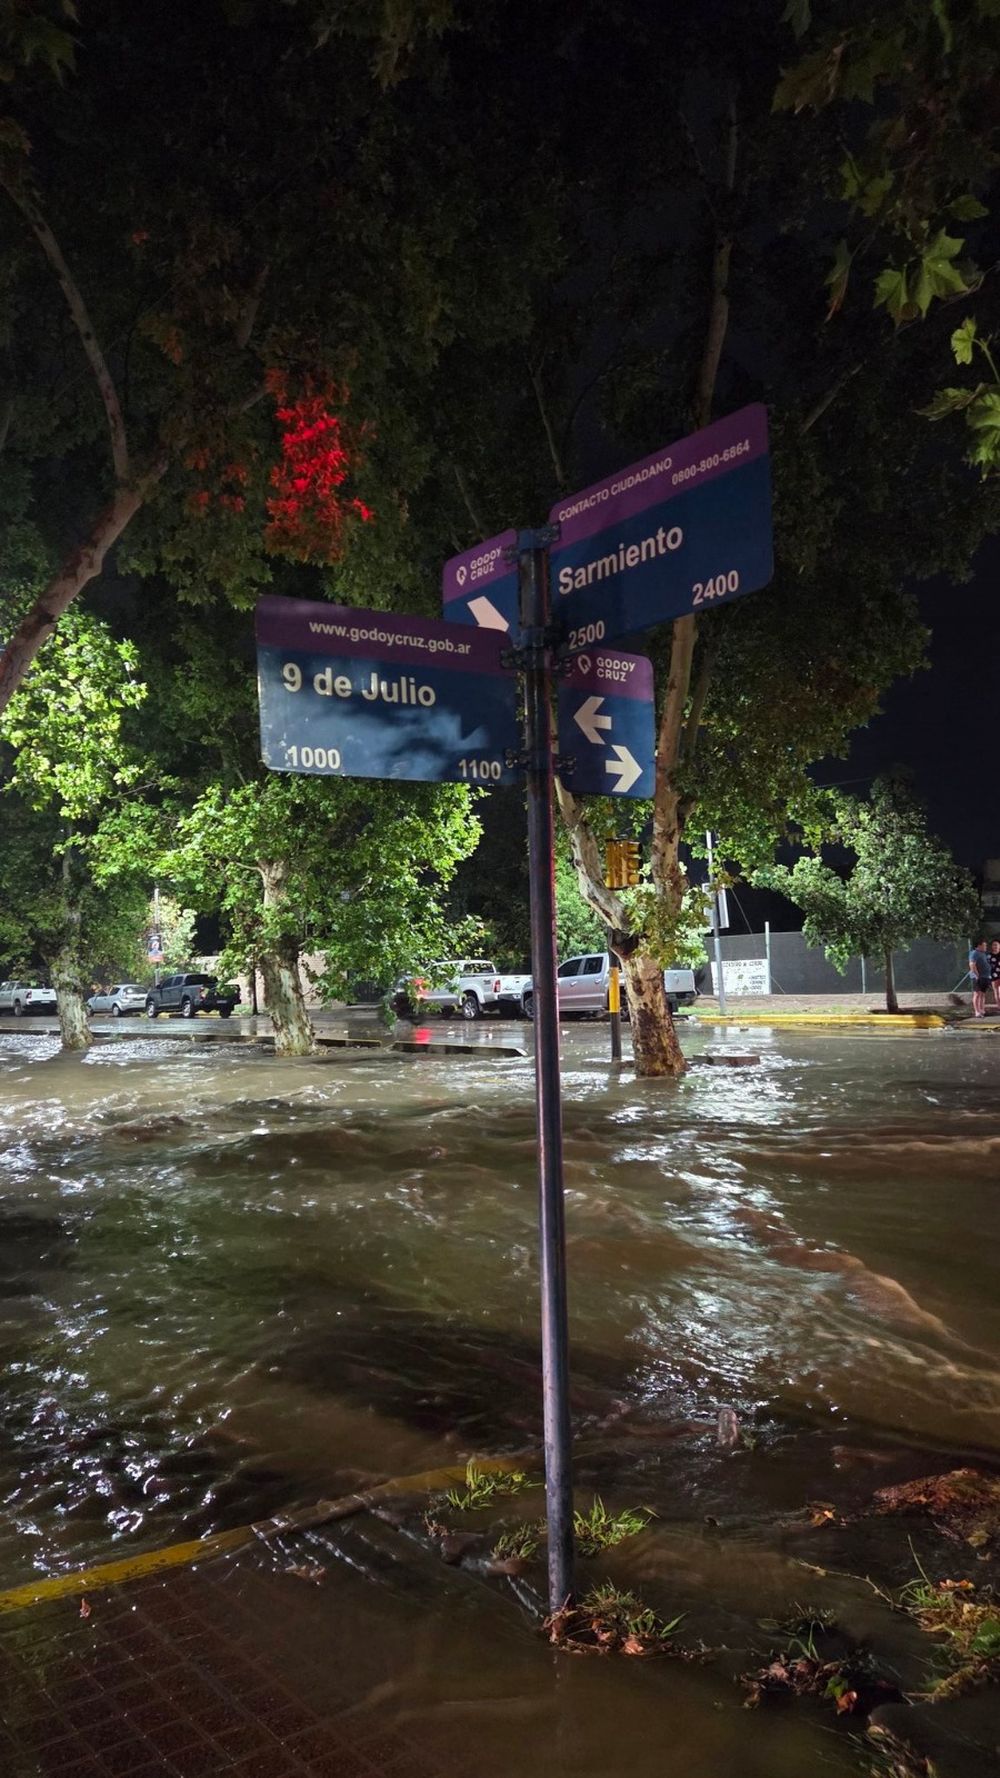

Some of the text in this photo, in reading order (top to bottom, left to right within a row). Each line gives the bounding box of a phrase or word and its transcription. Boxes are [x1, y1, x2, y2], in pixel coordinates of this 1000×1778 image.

[671, 439, 750, 486] 0800-800-6864
[558, 456, 673, 522] CONTACTO CIUDADANO
[470, 546, 502, 569] GODOY
[470, 561, 495, 581] CRUZ
[558, 526, 684, 595] Sarmiento
[691, 569, 740, 606] 2400
[308, 621, 471, 654] www.godoycruz.gob.ar
[568, 620, 606, 650] 2500
[596, 656, 636, 672] GODOY
[596, 668, 627, 682] CRUZ
[282, 662, 436, 706] 9 de Julio
[287, 745, 341, 769] 1000
[458, 758, 501, 779] 1100
